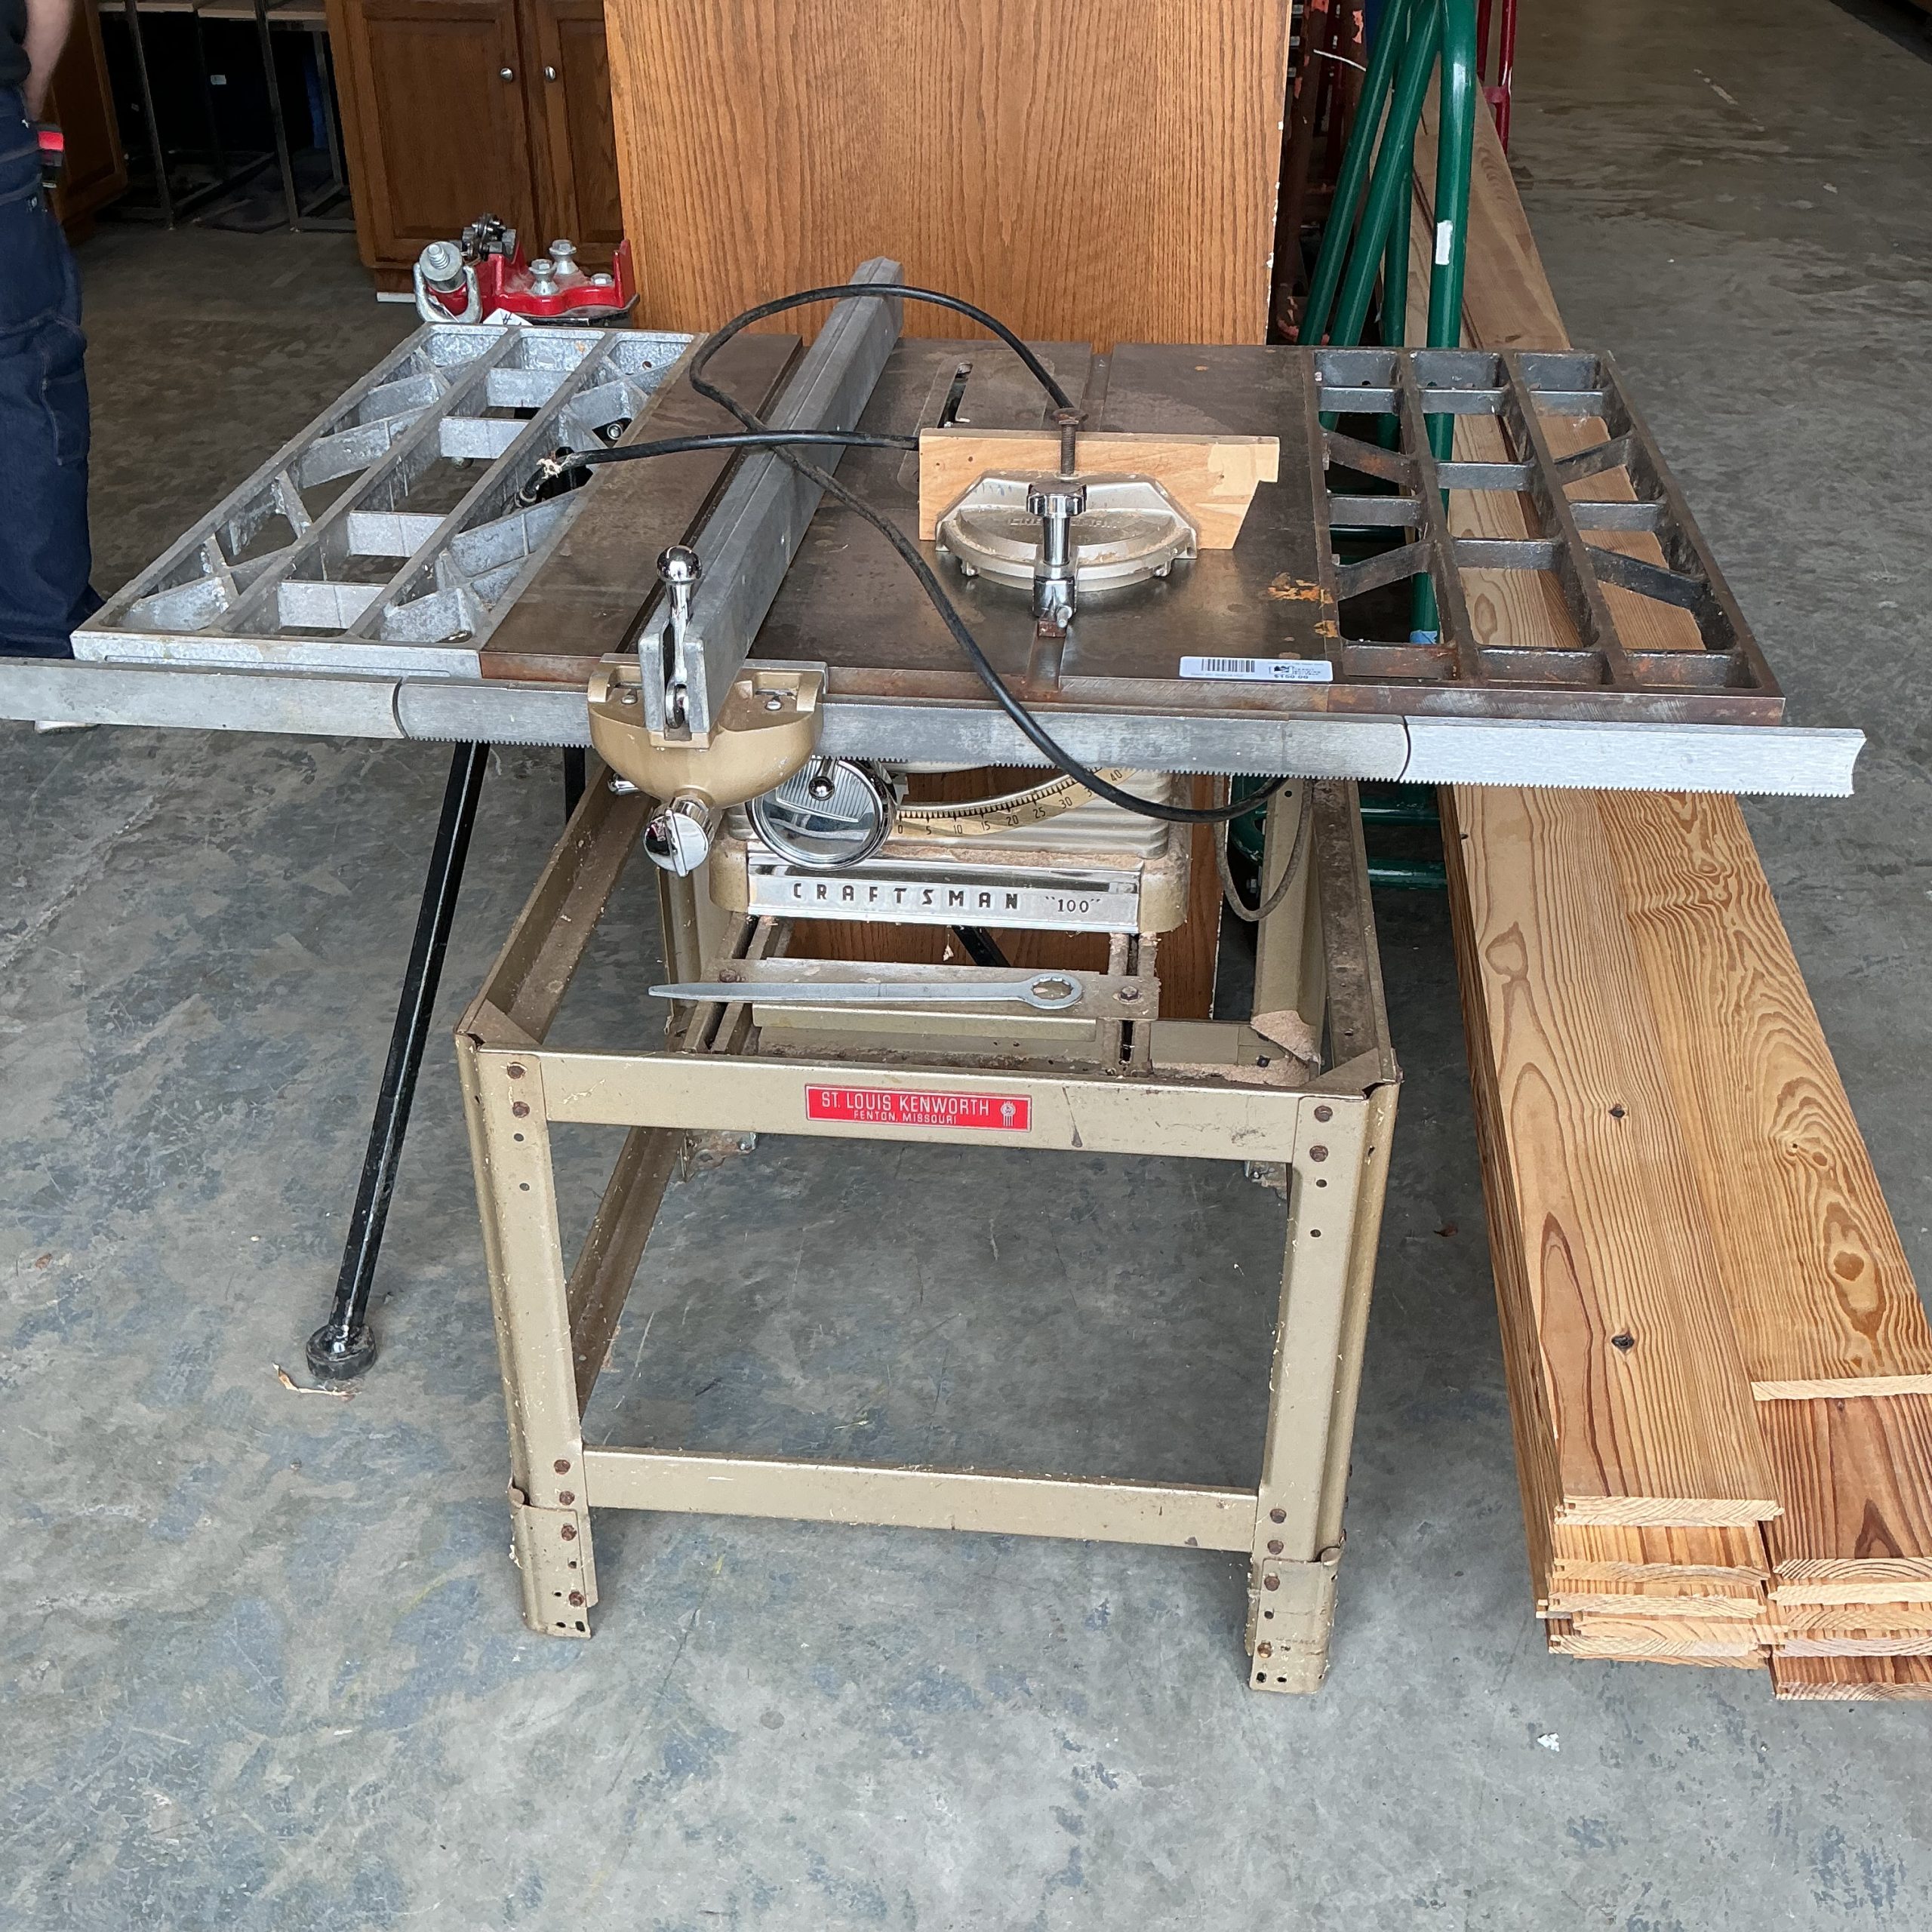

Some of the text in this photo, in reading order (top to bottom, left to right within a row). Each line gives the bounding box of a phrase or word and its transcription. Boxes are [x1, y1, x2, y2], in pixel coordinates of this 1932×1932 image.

[897, 825, 903, 833] 0
[926, 826, 932, 835] 5
[953, 824, 963, 834] 10
[981, 820, 991, 830] 15
[1006, 814, 1019, 826] 20
[1032, 807, 1046, 819] 25
[1058, 796, 1072, 809] 30
[1109, 769, 1123, 781] 40
[793, 883, 1017, 909] CRAFTSMAN
[822, 1091, 989, 1115] ST. LOUIS KENWORTH
[902, 1113, 956, 1124] MISSOURI
